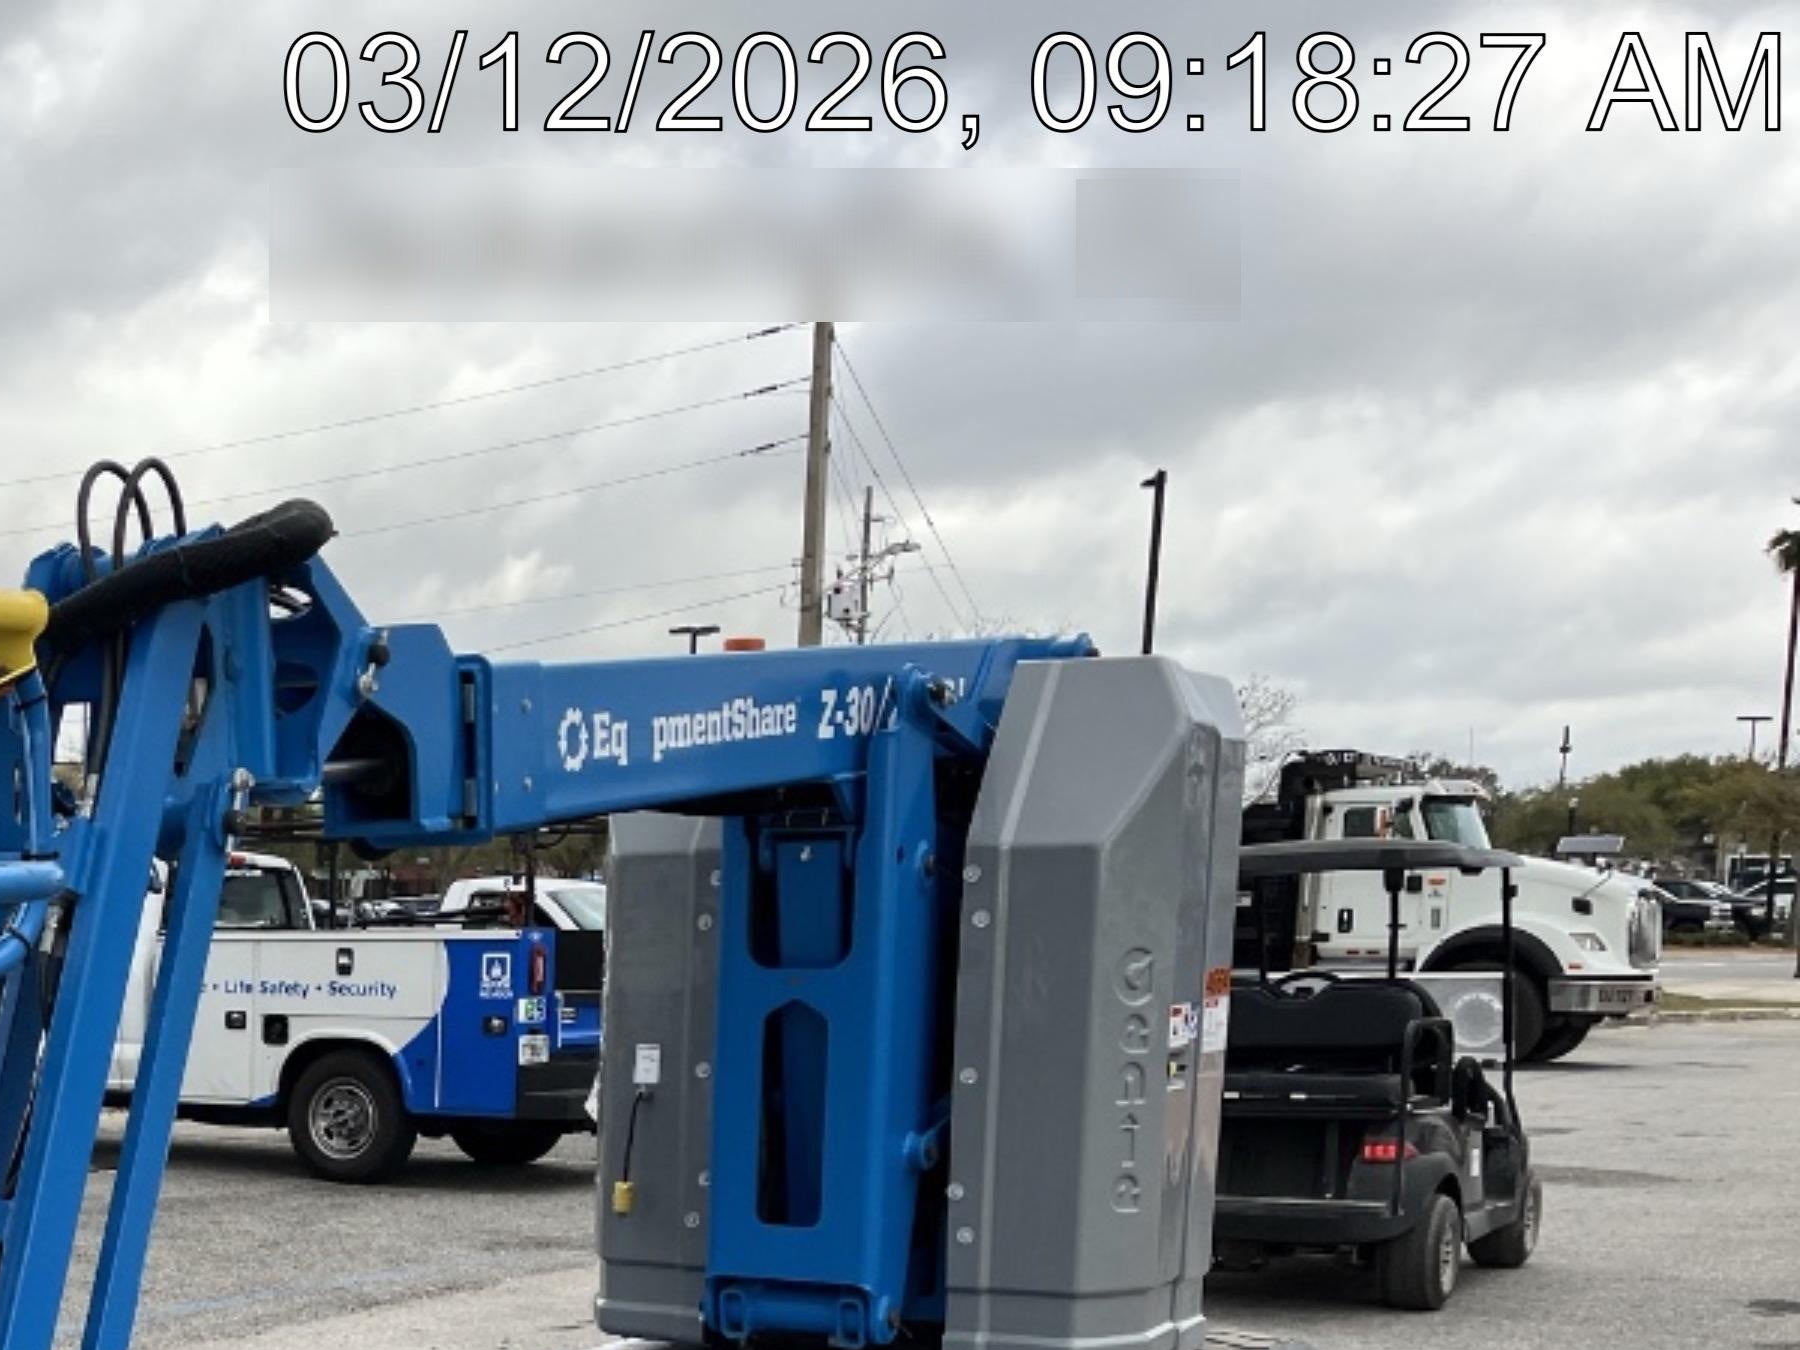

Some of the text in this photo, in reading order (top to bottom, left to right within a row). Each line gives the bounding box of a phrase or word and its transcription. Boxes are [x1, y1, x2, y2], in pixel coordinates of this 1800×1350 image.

[224, 979, 254, 994] Life
[259, 979, 310, 999] Safety
[327, 979, 398, 1000] Security
